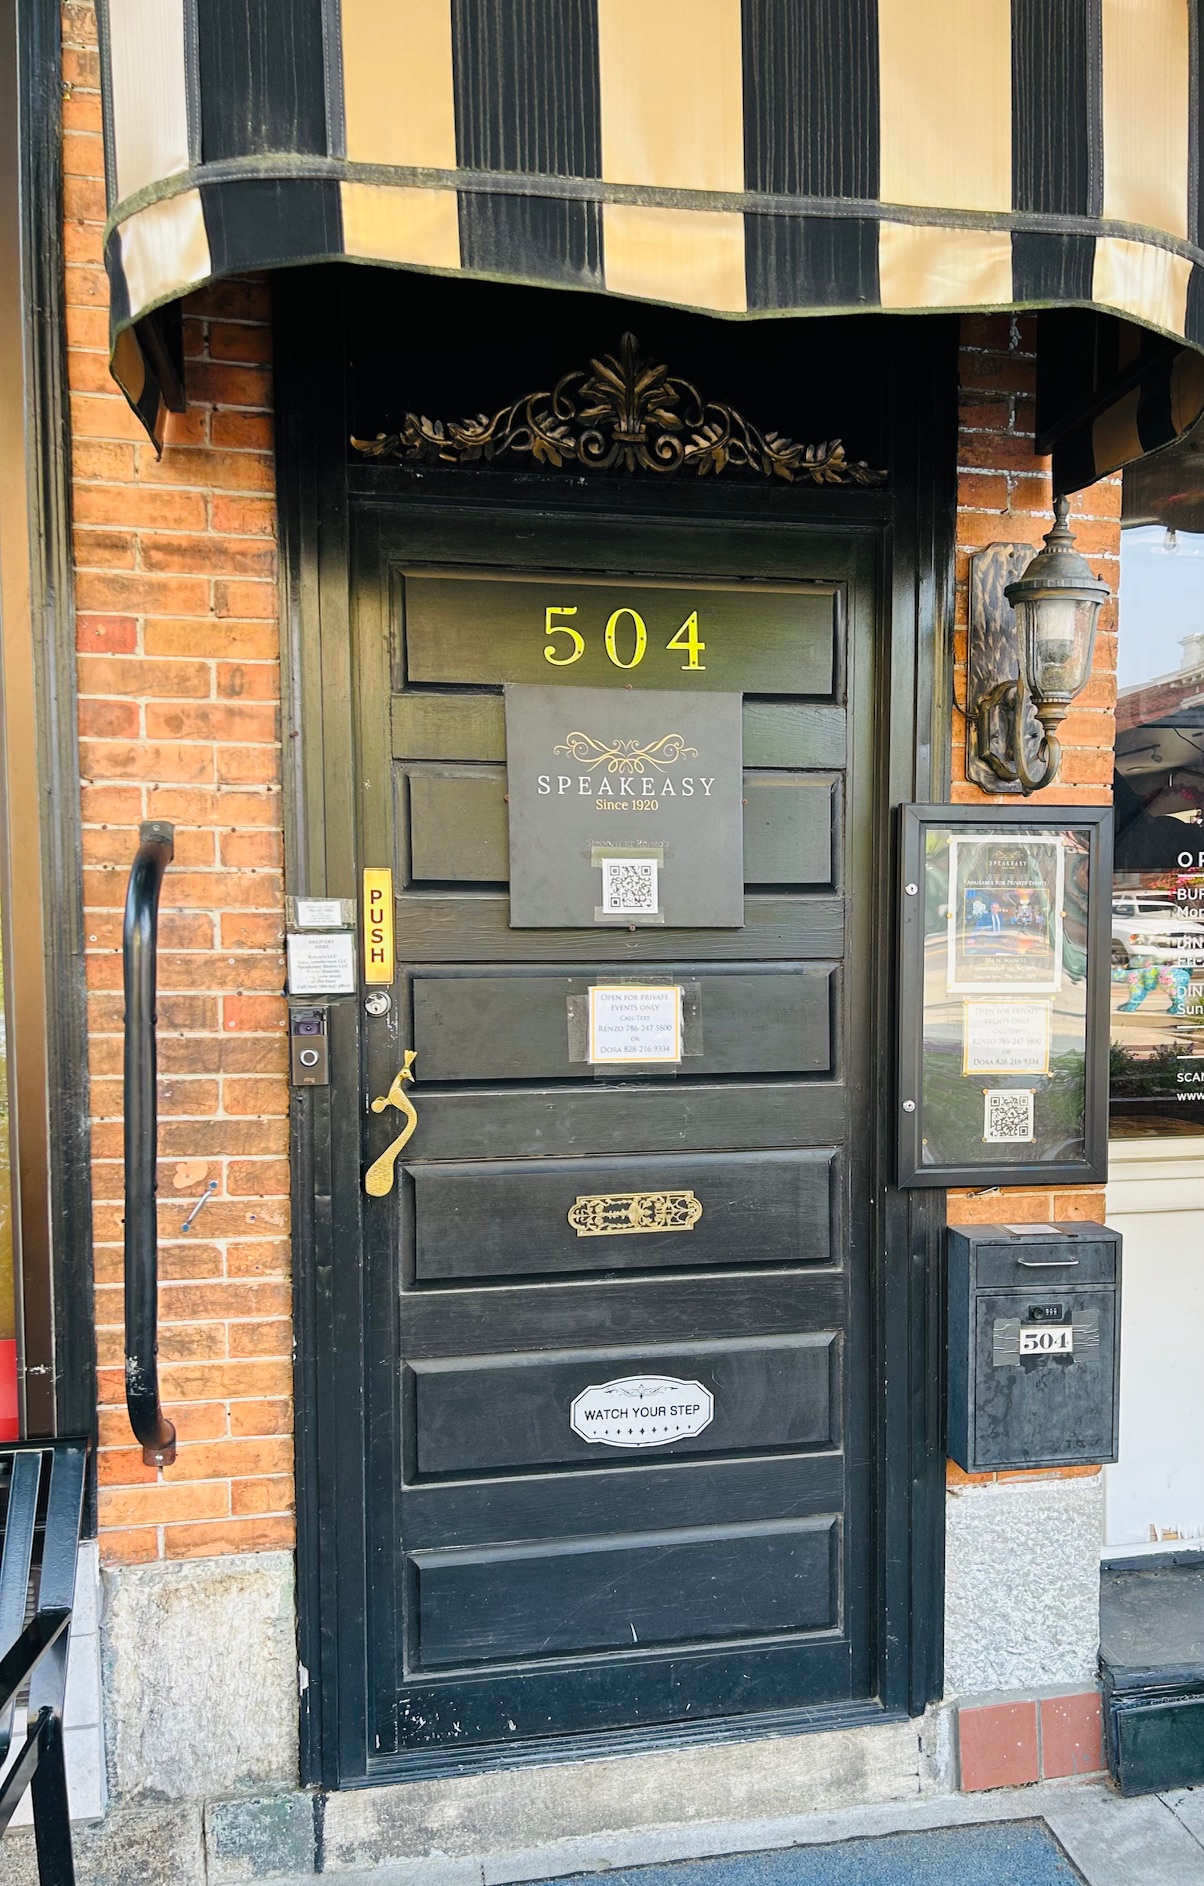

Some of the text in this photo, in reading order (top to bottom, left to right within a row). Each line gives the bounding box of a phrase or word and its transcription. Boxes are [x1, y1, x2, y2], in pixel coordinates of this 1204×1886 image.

[543, 606, 706, 671] 504
[537, 775, 716, 797] SPEAKEASY
[595, 798, 659, 811] Since 1920
[370, 889, 384, 963] PUSH
[975, 1007, 995, 1015] OPEN
[972, 1037, 997, 1045] RENZO
[623, 1045, 652, 1053] 828-216
[973, 1058, 995, 1066] DORA
[1023, 1332, 1069, 1351] 504
[584, 1404, 700, 1421] WATCH YOUR STEP
